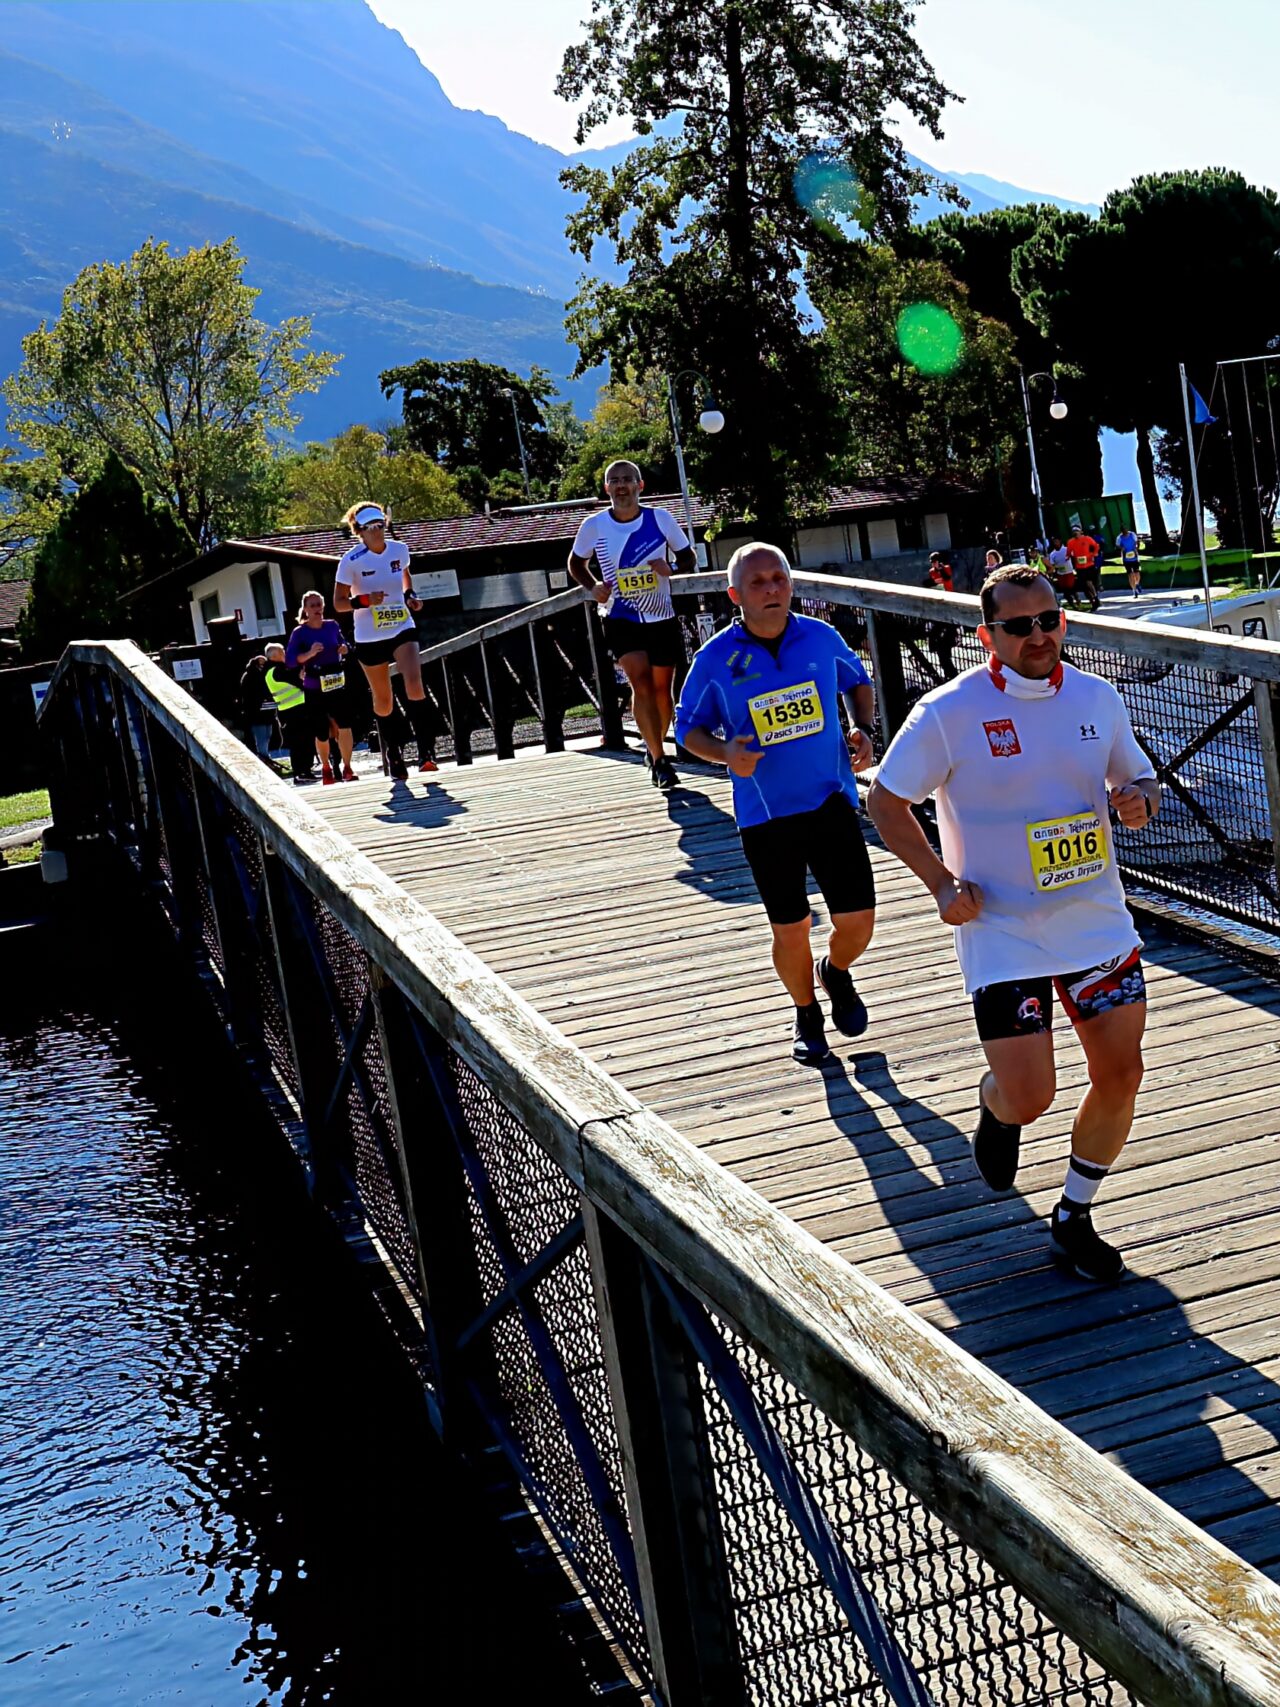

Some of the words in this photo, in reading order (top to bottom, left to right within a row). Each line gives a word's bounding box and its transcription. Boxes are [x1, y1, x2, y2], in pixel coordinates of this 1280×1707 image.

[623, 574, 654, 588] 1516
[377, 609, 404, 621] 2659
[763, 698, 815, 726] 1538
[985, 720, 1010, 728] POLSKA
[1043, 832, 1098, 865] 1016
